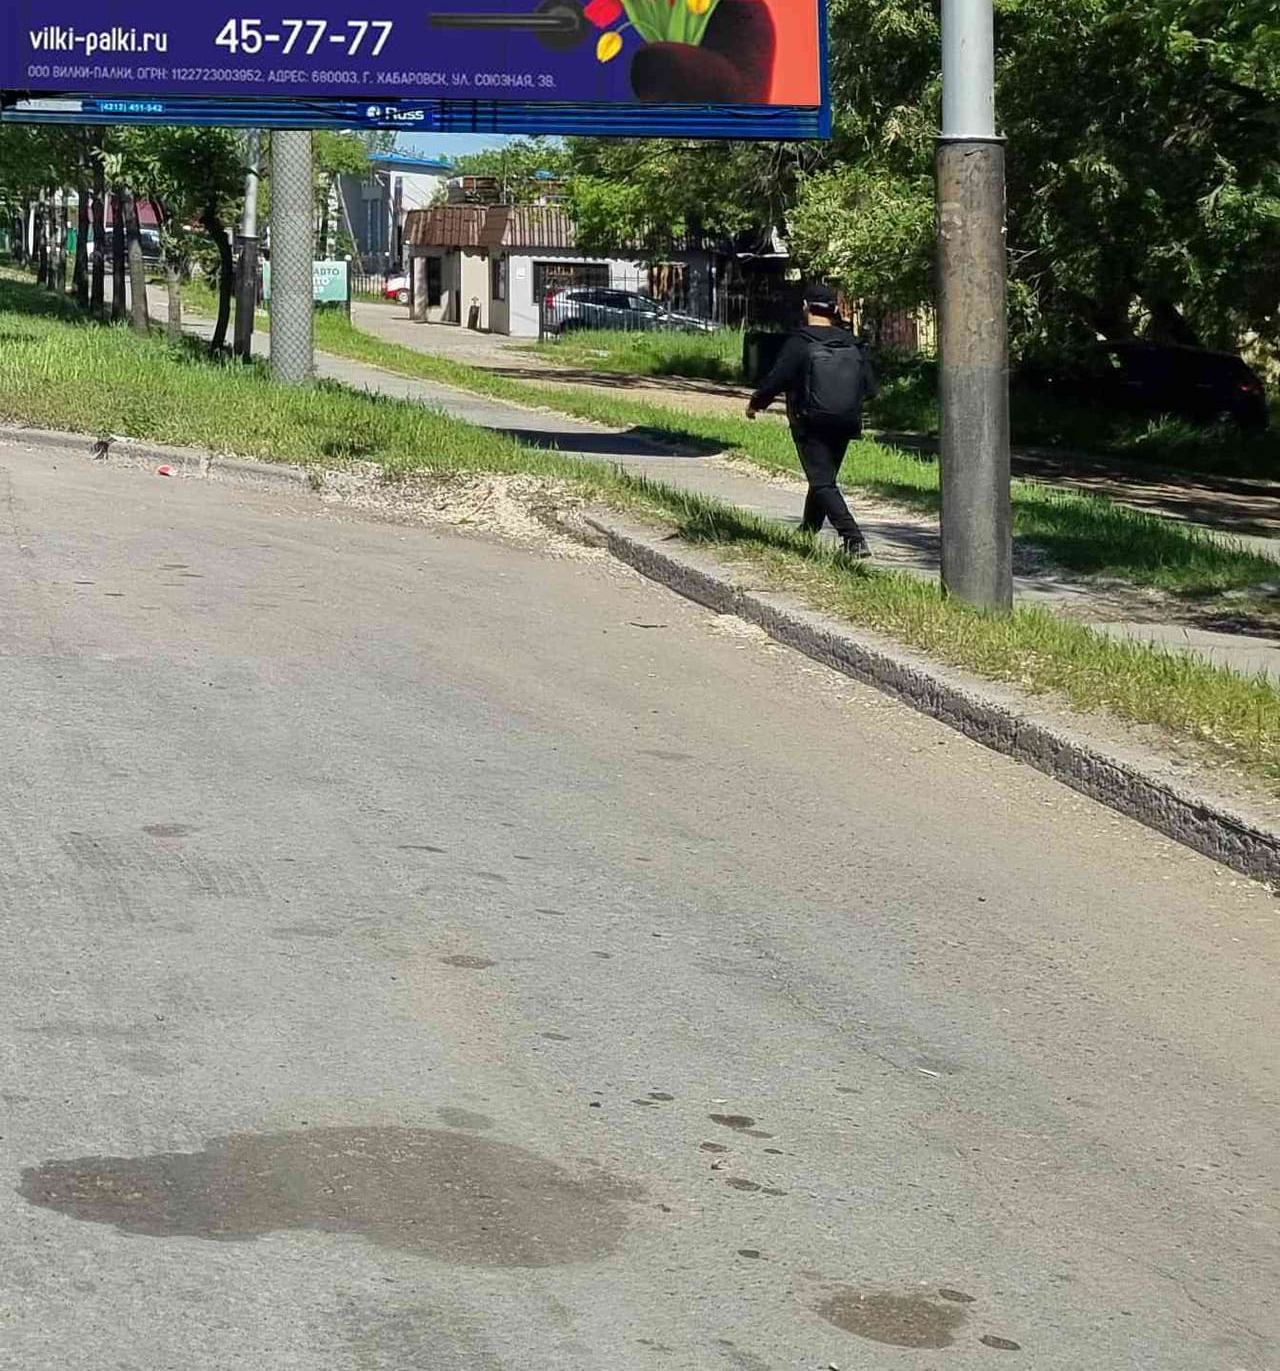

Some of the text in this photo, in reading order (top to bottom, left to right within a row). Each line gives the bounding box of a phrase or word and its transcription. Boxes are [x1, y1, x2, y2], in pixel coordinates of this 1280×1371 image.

[29, 26, 169, 56] vilki-palki.ru
[214, 18, 394, 56] 45-77-77
[27, 65, 51, 78] ООО
